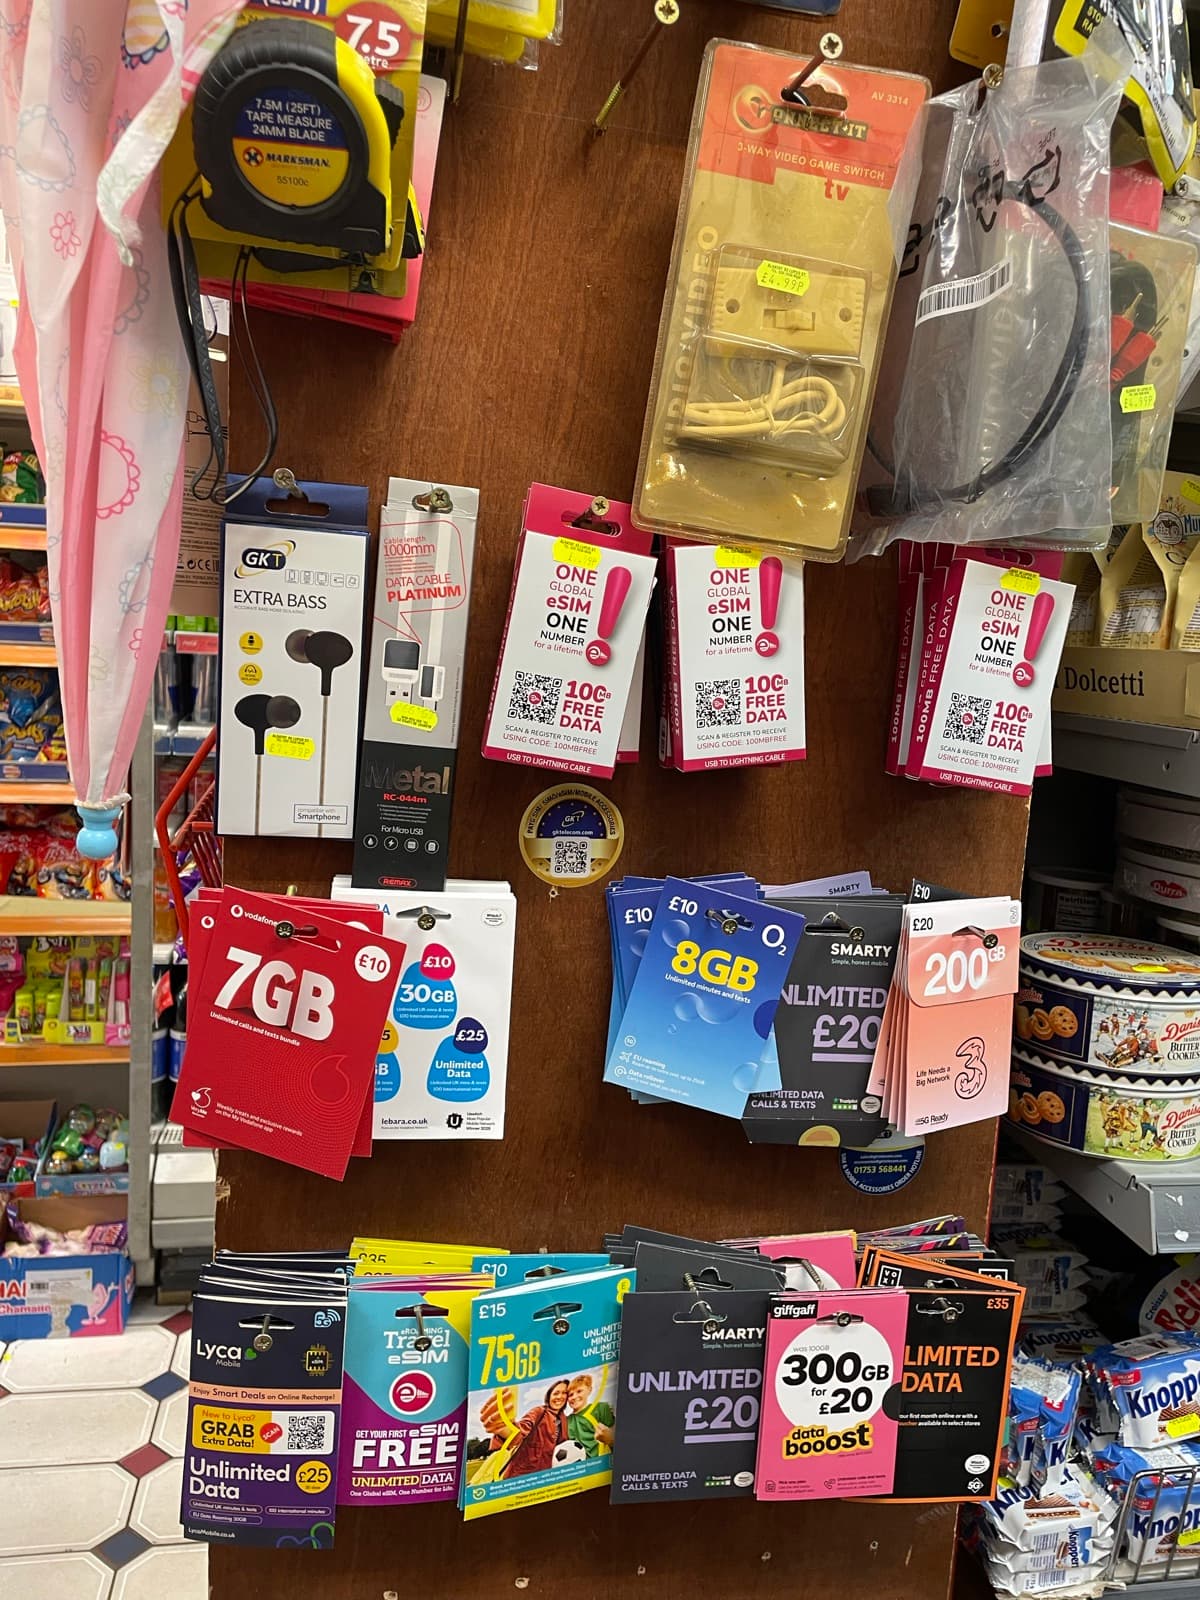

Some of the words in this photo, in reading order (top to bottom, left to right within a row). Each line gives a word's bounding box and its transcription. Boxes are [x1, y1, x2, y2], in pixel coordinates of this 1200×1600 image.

[346, 14, 402, 57] 7.5
[871, 91, 885, 101] AV
[886, 94, 909, 105] 3314
[256, 98, 283, 112] 7.5M
[286, 101, 321, 117] (25FT)
[246, 110, 275, 124] TAPE
[277, 114, 332, 130] MEASURE
[252, 124, 286, 137] 24MM
[289, 128, 326, 142] BLADE
[737, 142, 771, 158] 3-WAY
[775, 150, 806, 166] VIDEO
[809, 158, 841, 174] GAME
[844, 164, 885, 180] SWITCH
[824, 178, 850, 201] tv
[383, 542, 436, 557] 1000mm
[245, 551, 283, 567] GKT
[386, 575, 414, 588] DATA
[416, 573, 452, 585] CABLE
[555, 564, 599, 586] ONE
[710, 567, 750, 585] ONE
[387, 584, 461, 603] PLATINUM
[549, 581, 594, 598] GLOBAL
[707, 586, 750, 597] GLOBAL
[233, 589, 283, 606] EXTRA
[287, 593, 328, 610] BASS
[546, 595, 592, 615] eSIM
[708, 597, 750, 614] eSIM
[991, 590, 1027, 611] ONE
[985, 606, 1022, 622] GLOBAL
[546, 612, 589, 634] ONE
[712, 616, 752, 632] ONE
[981, 621, 1020, 638] eSIM
[540, 630, 585, 646] NUMBER
[710, 635, 752, 646] NUMBER
[981, 636, 1016, 656] ONE
[974, 654, 1012, 668] NUMBER
[1064, 667, 1145, 697] Dolcetti
[562, 700, 605, 719] FREE
[745, 694, 785, 709] FREE
[559, 715, 602, 734] DATA
[746, 709, 787, 724] DATA
[990, 720, 1027, 738] FREE
[503, 733, 527, 743] USING
[529, 737, 551, 748] CODE:
[554, 742, 598, 755] 100MBFREE
[987, 735, 1024, 752] DATA
[506, 752, 521, 761] USB
[522, 755, 532, 763] TO
[532, 758, 569, 770] LIGHTNING
[569, 763, 592, 774] CABLE
[704, 760, 719, 768] USB
[729, 754, 763, 766] LIGHTNING
[764, 752, 786, 761] CABLE
[365, 760, 450, 795] Metal
[939, 772, 952, 781] USB
[953, 775, 962, 783] TO
[962, 776, 994, 789] LIGHTNING
[993, 782, 1013, 792] CABLE
[383, 793, 427, 804] RC-044m
[297, 812, 341, 821] Smartphone
[381, 825, 391, 833] For
[392, 826, 409, 834] Micro
[409, 827, 423, 836] USB
[828, 882, 861, 895] SMARTY
[915, 884, 930, 899] £10
[668, 896, 698, 916] £10
[244, 910, 279, 928] vodafone
[624, 907, 653, 924] £10
[912, 917, 934, 931] £20
[761, 924, 787, 956] O2
[830, 943, 892, 958] SMARTY
[358, 953, 388, 974] £10
[423, 956, 452, 968] £10
[671, 940, 760, 993] 8GB
[214, 946, 336, 1042] 7GB
[399, 984, 455, 1003] 30GB
[781, 984, 888, 1009] NLIMITED
[456, 1029, 485, 1042] £25
[813, 1014, 881, 1049] £20
[1161, 1017, 1200, 1042] Danis
[1170, 1041, 1199, 1051] BUTTER
[1167, 1050, 1200, 1061] COOKIES
[435, 1060, 484, 1070] Unlimited
[447, 1069, 471, 1078] Data
[915, 1077, 926, 1086] Big
[926, 1074, 951, 1085] Network
[751, 1099, 779, 1109] CALLS
[780, 1101, 787, 1109] &
[789, 1100, 817, 1110] TEXTS
[381, 1117, 428, 1126] lebara.co.uk
[1161, 1103, 1200, 1130] Danis
[1170, 1129, 1197, 1139] BUTTER
[1167, 1137, 1197, 1149] COOKIES
[853, 1165, 876, 1174] 01753
[878, 1164, 907, 1174] 568441
[482, 1263, 508, 1277] £10
[479, 1303, 507, 1319] £15
[773, 1303, 817, 1318] giffgaff
[987, 1297, 1010, 1310] £35
[702, 1327, 766, 1341] SMARTY
[196, 1338, 242, 1360] Lyca
[388, 1349, 449, 1365] eSIM
[215, 1359, 241, 1368] Mobile
[478, 1333, 541, 1386] 75GB
[782, 1351, 890, 1387] 300GB
[628, 1368, 763, 1393] UNLIMITED
[901, 1372, 963, 1393] DATA
[193, 1387, 210, 1397] Enjoy
[212, 1388, 239, 1399] Smart
[241, 1390, 266, 1400] Deals
[277, 1392, 300, 1401] Online
[301, 1391, 336, 1403] Recharge!
[811, 1387, 827, 1397] for
[818, 1386, 874, 1415] £20
[1125, 1371, 1200, 1419] Knopp
[202, 1408, 220, 1418] New
[222, 1411, 231, 1420] to
[233, 1413, 256, 1423] Lyca?
[684, 1395, 760, 1431] £20
[200, 1419, 255, 1438] GRAB
[262, 1424, 280, 1441] SCAN
[355, 1428, 369, 1439] GET
[370, 1428, 387, 1438] YOUR
[388, 1428, 408, 1438] FIRST
[408, 1421, 460, 1438] eSIM
[791, 1427, 825, 1441] data
[201, 1436, 225, 1447] Extra
[227, 1438, 255, 1448] Data!
[352, 1436, 460, 1469] FREE
[190, 1455, 292, 1483] Unlimited
[298, 1467, 329, 1484] £25
[621, 1473, 671, 1483] UNLIMITED
[673, 1471, 698, 1480] DATA
[189, 1477, 240, 1500] Data
[351, 1475, 420, 1488] UNLIMITED
[421, 1473, 454, 1486] DATA
[621, 1482, 650, 1492] CALLS
[651, 1482, 659, 1490] &
[661, 1480, 689, 1489] TEXTS
